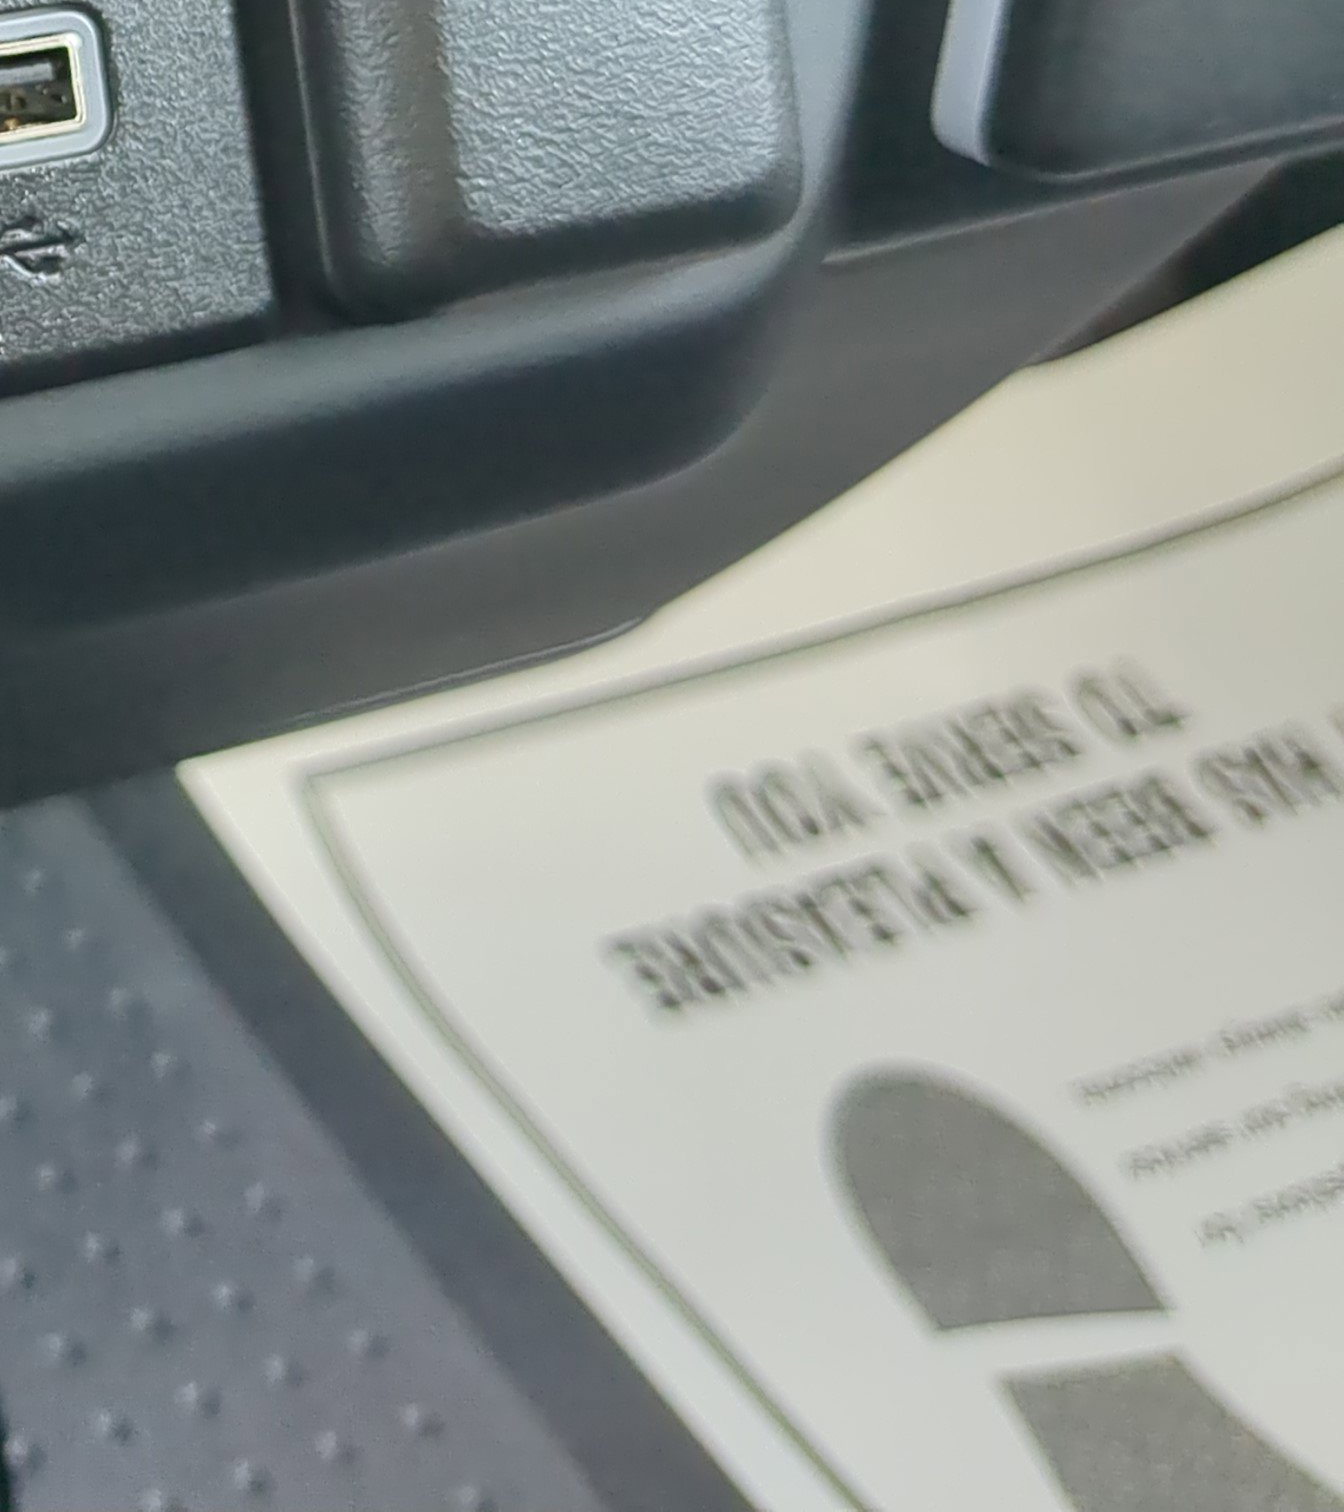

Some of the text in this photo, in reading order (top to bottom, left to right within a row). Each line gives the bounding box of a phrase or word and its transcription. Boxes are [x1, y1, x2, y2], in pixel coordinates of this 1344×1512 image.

[708, 664, 1190, 862] TO SERVE YOU
[1026, 772, 1218, 884] BEEN
[606, 852, 978, 1014] PLEASURE
